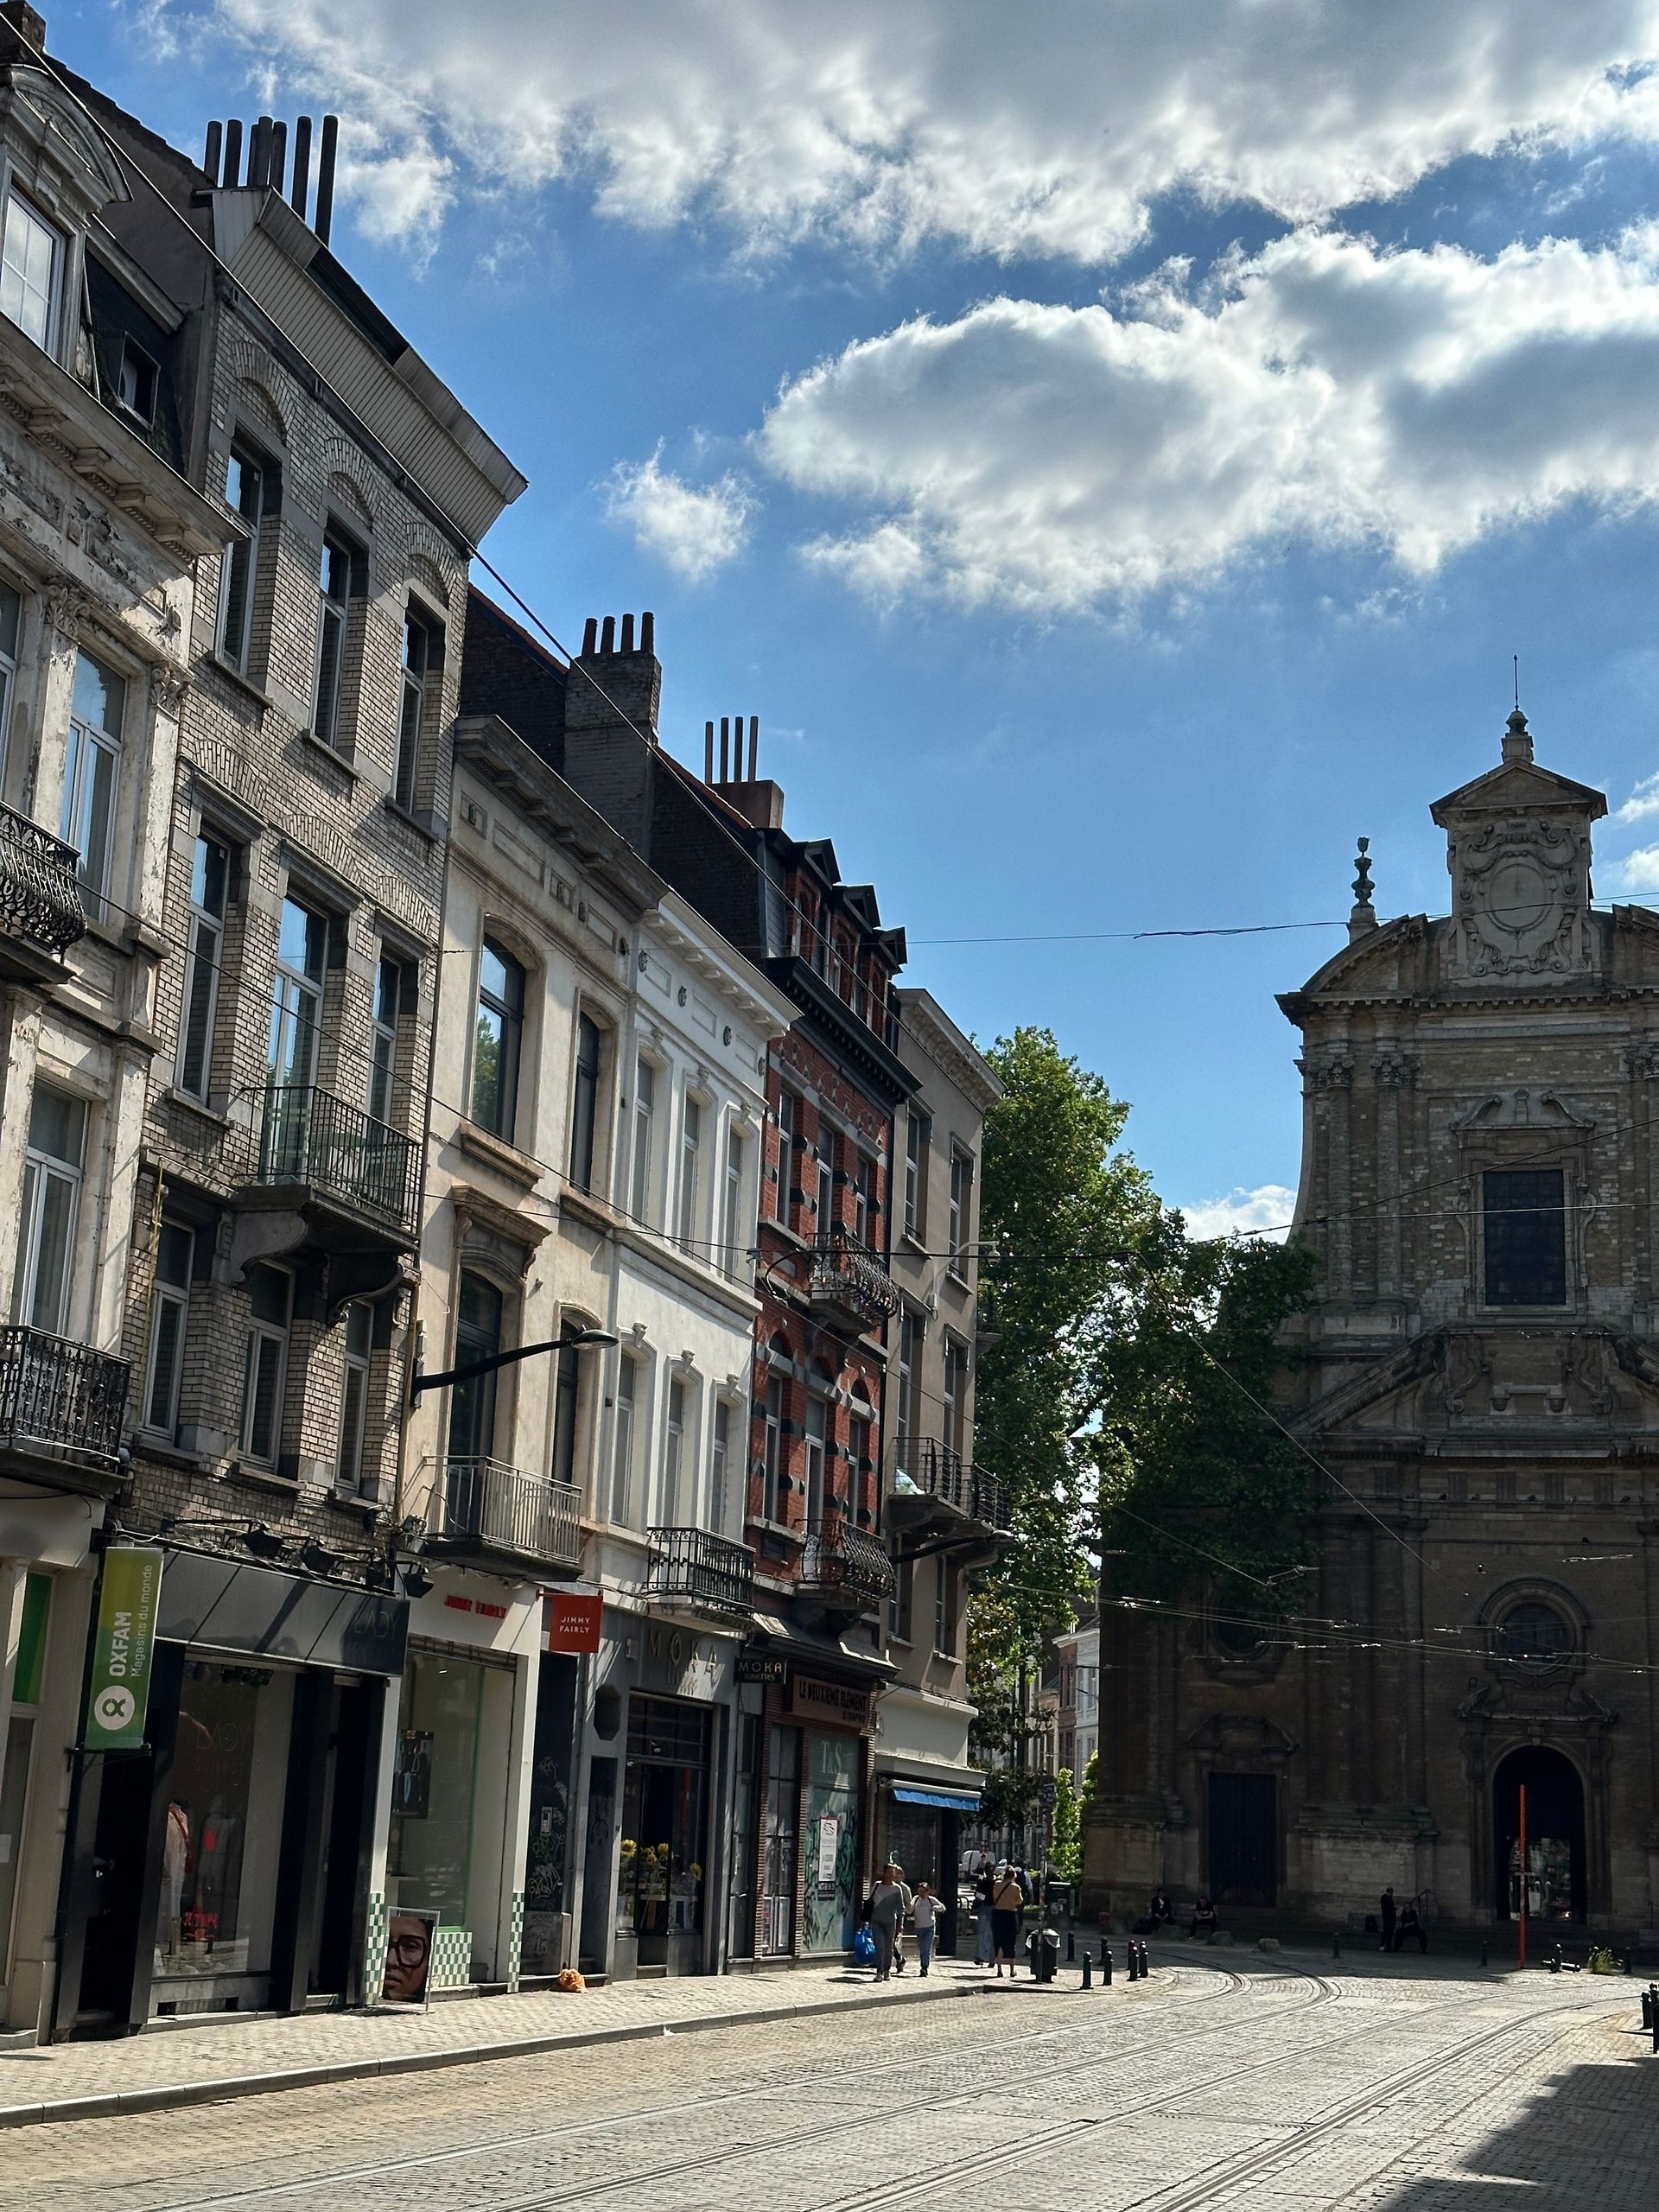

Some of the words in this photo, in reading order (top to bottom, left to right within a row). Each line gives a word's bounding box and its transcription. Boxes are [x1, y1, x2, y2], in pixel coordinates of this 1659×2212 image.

[141, 1564, 153, 1602] monde
[138, 1605, 149, 1620] du
[354, 1610, 401, 1639] LADY
[109, 1611, 132, 1677] OXFAM
[559, 1625, 591, 1634] FAIRLY
[130, 1622, 147, 1677] Magasins
[650, 1630, 718, 1675] MOKA
[739, 1662, 782, 1673] MOKA
[799, 1679, 806, 1699] LE
[196, 1720, 251, 1754] LADY
